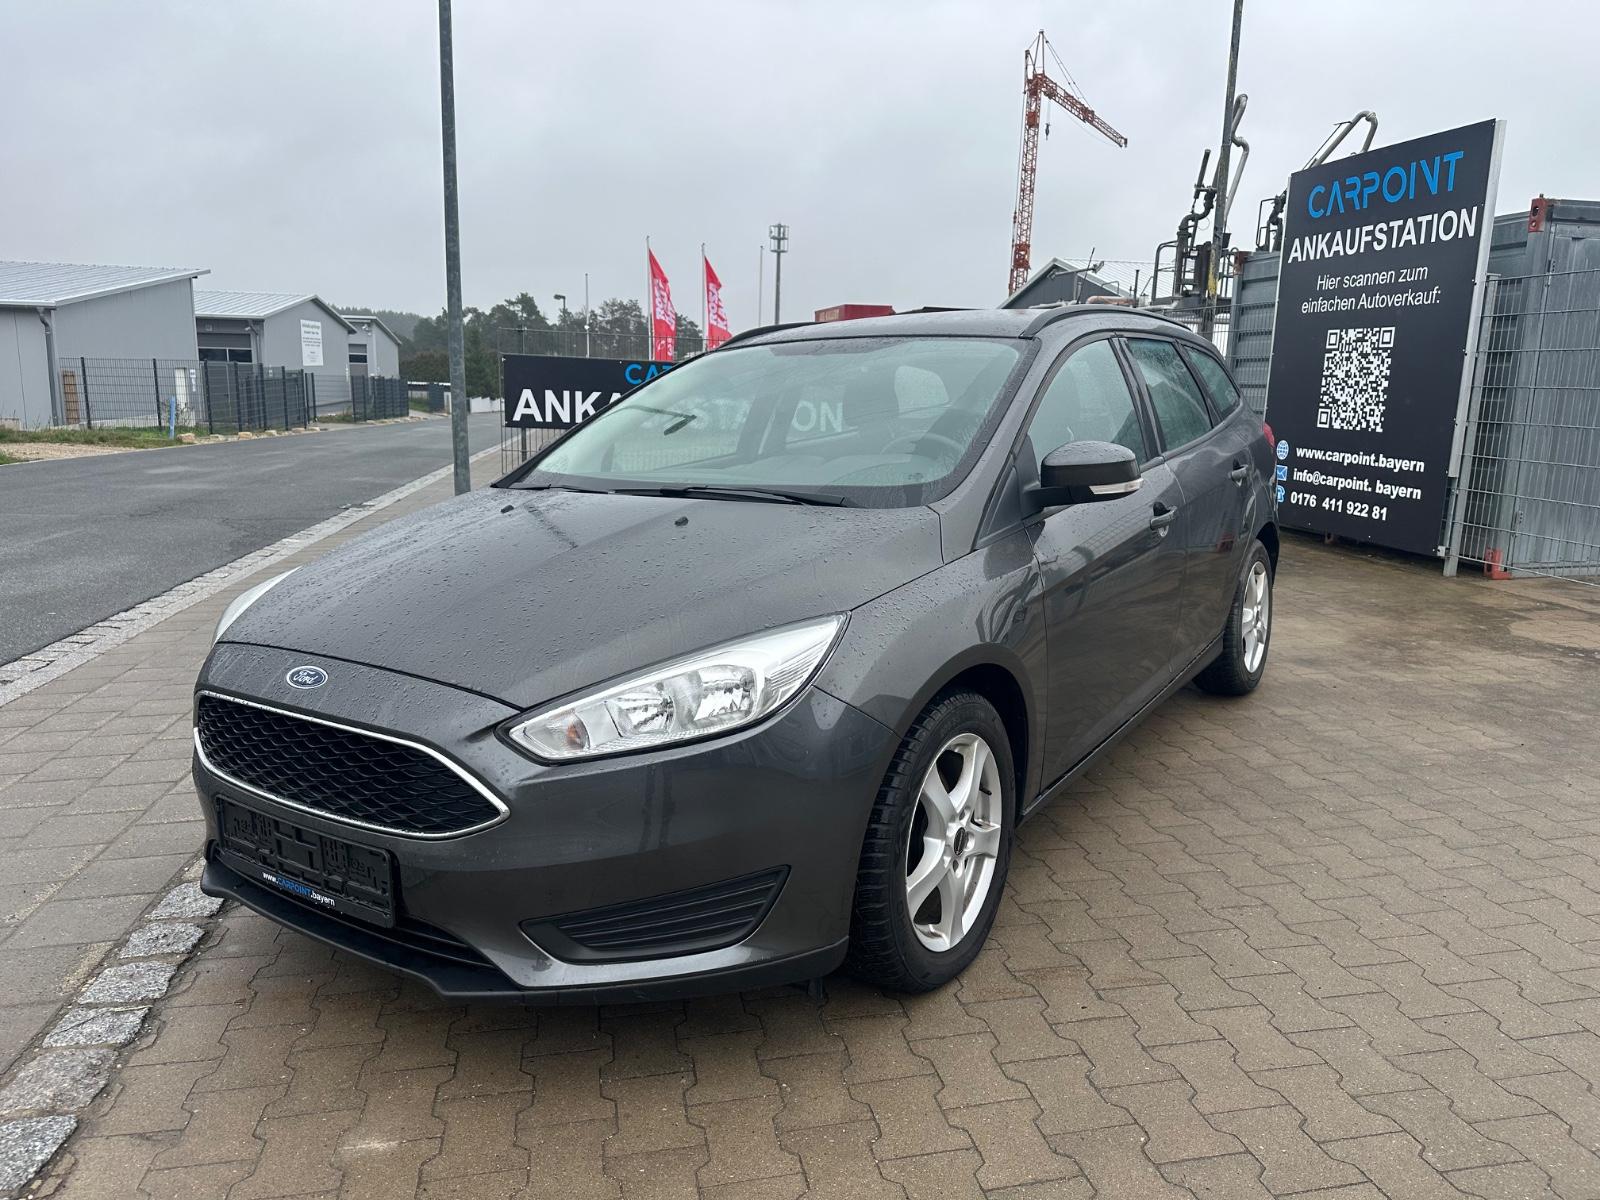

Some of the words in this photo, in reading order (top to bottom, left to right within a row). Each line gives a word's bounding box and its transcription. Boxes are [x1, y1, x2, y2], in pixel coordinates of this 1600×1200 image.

[1307, 150, 1464, 219] CARPOINT
[1287, 206, 1478, 264] ANKAUFSTATION
[1316, 274, 1341, 291] Hier
[1342, 268, 1396, 288] scannen
[1398, 266, 1429, 283] zum
[1301, 292, 1357, 314] einfachen
[1296, 447, 1426, 473] www.carpoint.bayern
[1375, 480, 1422, 500] bayern
[1290, 491, 1317, 508] 0176
[1322, 497, 1343, 513] 411
[1346, 501, 1369, 518] 922
[1371, 506, 1388, 522] 81
[293, 669, 319, 685] Ford
